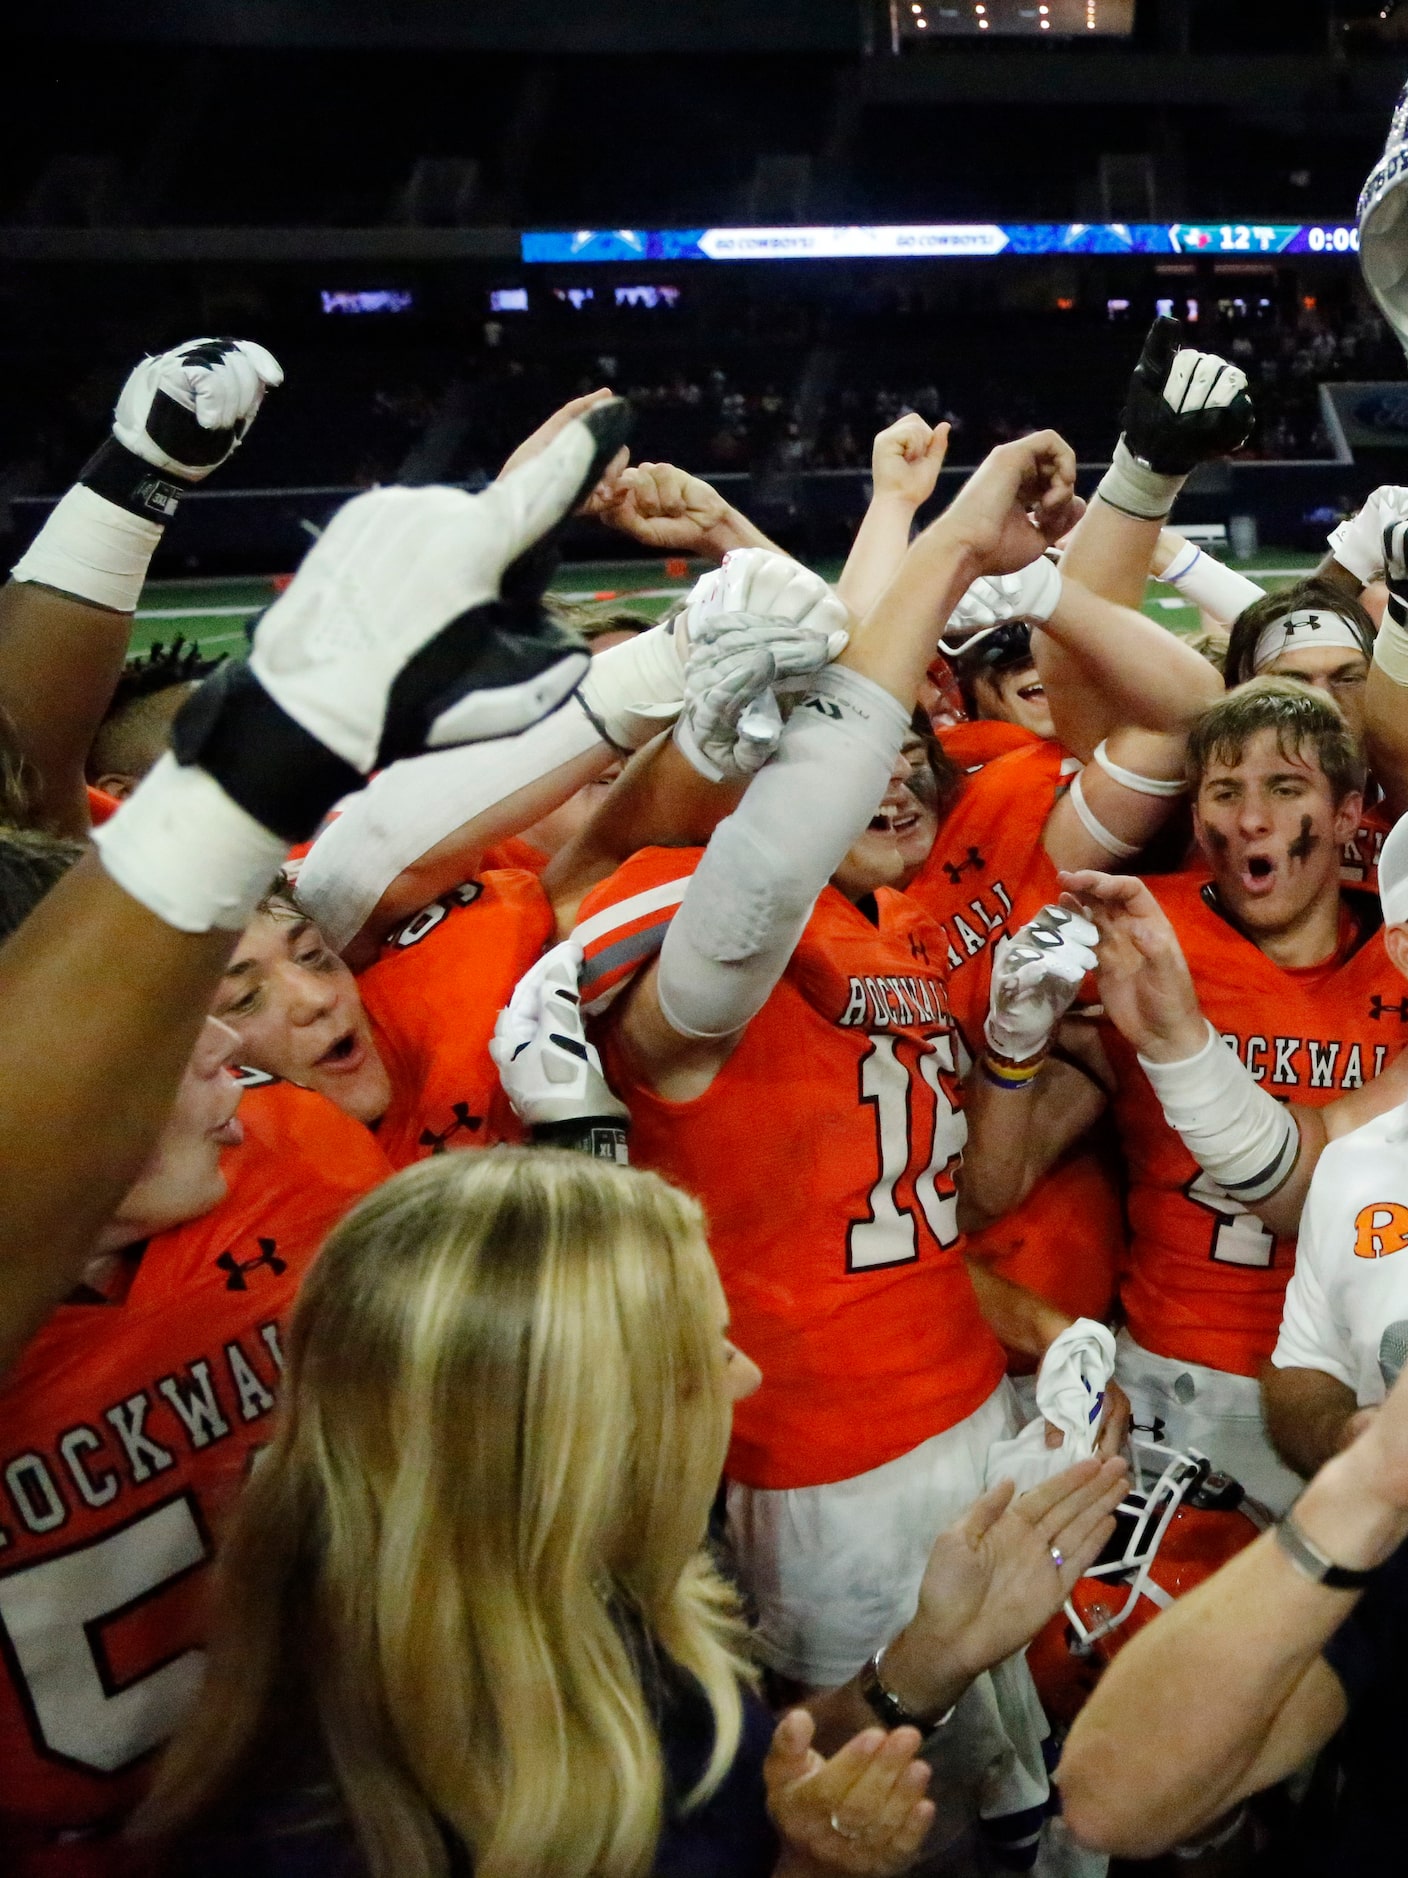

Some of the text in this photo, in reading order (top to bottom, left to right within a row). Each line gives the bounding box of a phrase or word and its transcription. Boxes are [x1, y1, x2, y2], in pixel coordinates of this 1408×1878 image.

[1219, 226, 1250, 250] 12
[600, 1143, 613, 1157] XL
[0, 1324, 284, 1548] OCKWA
